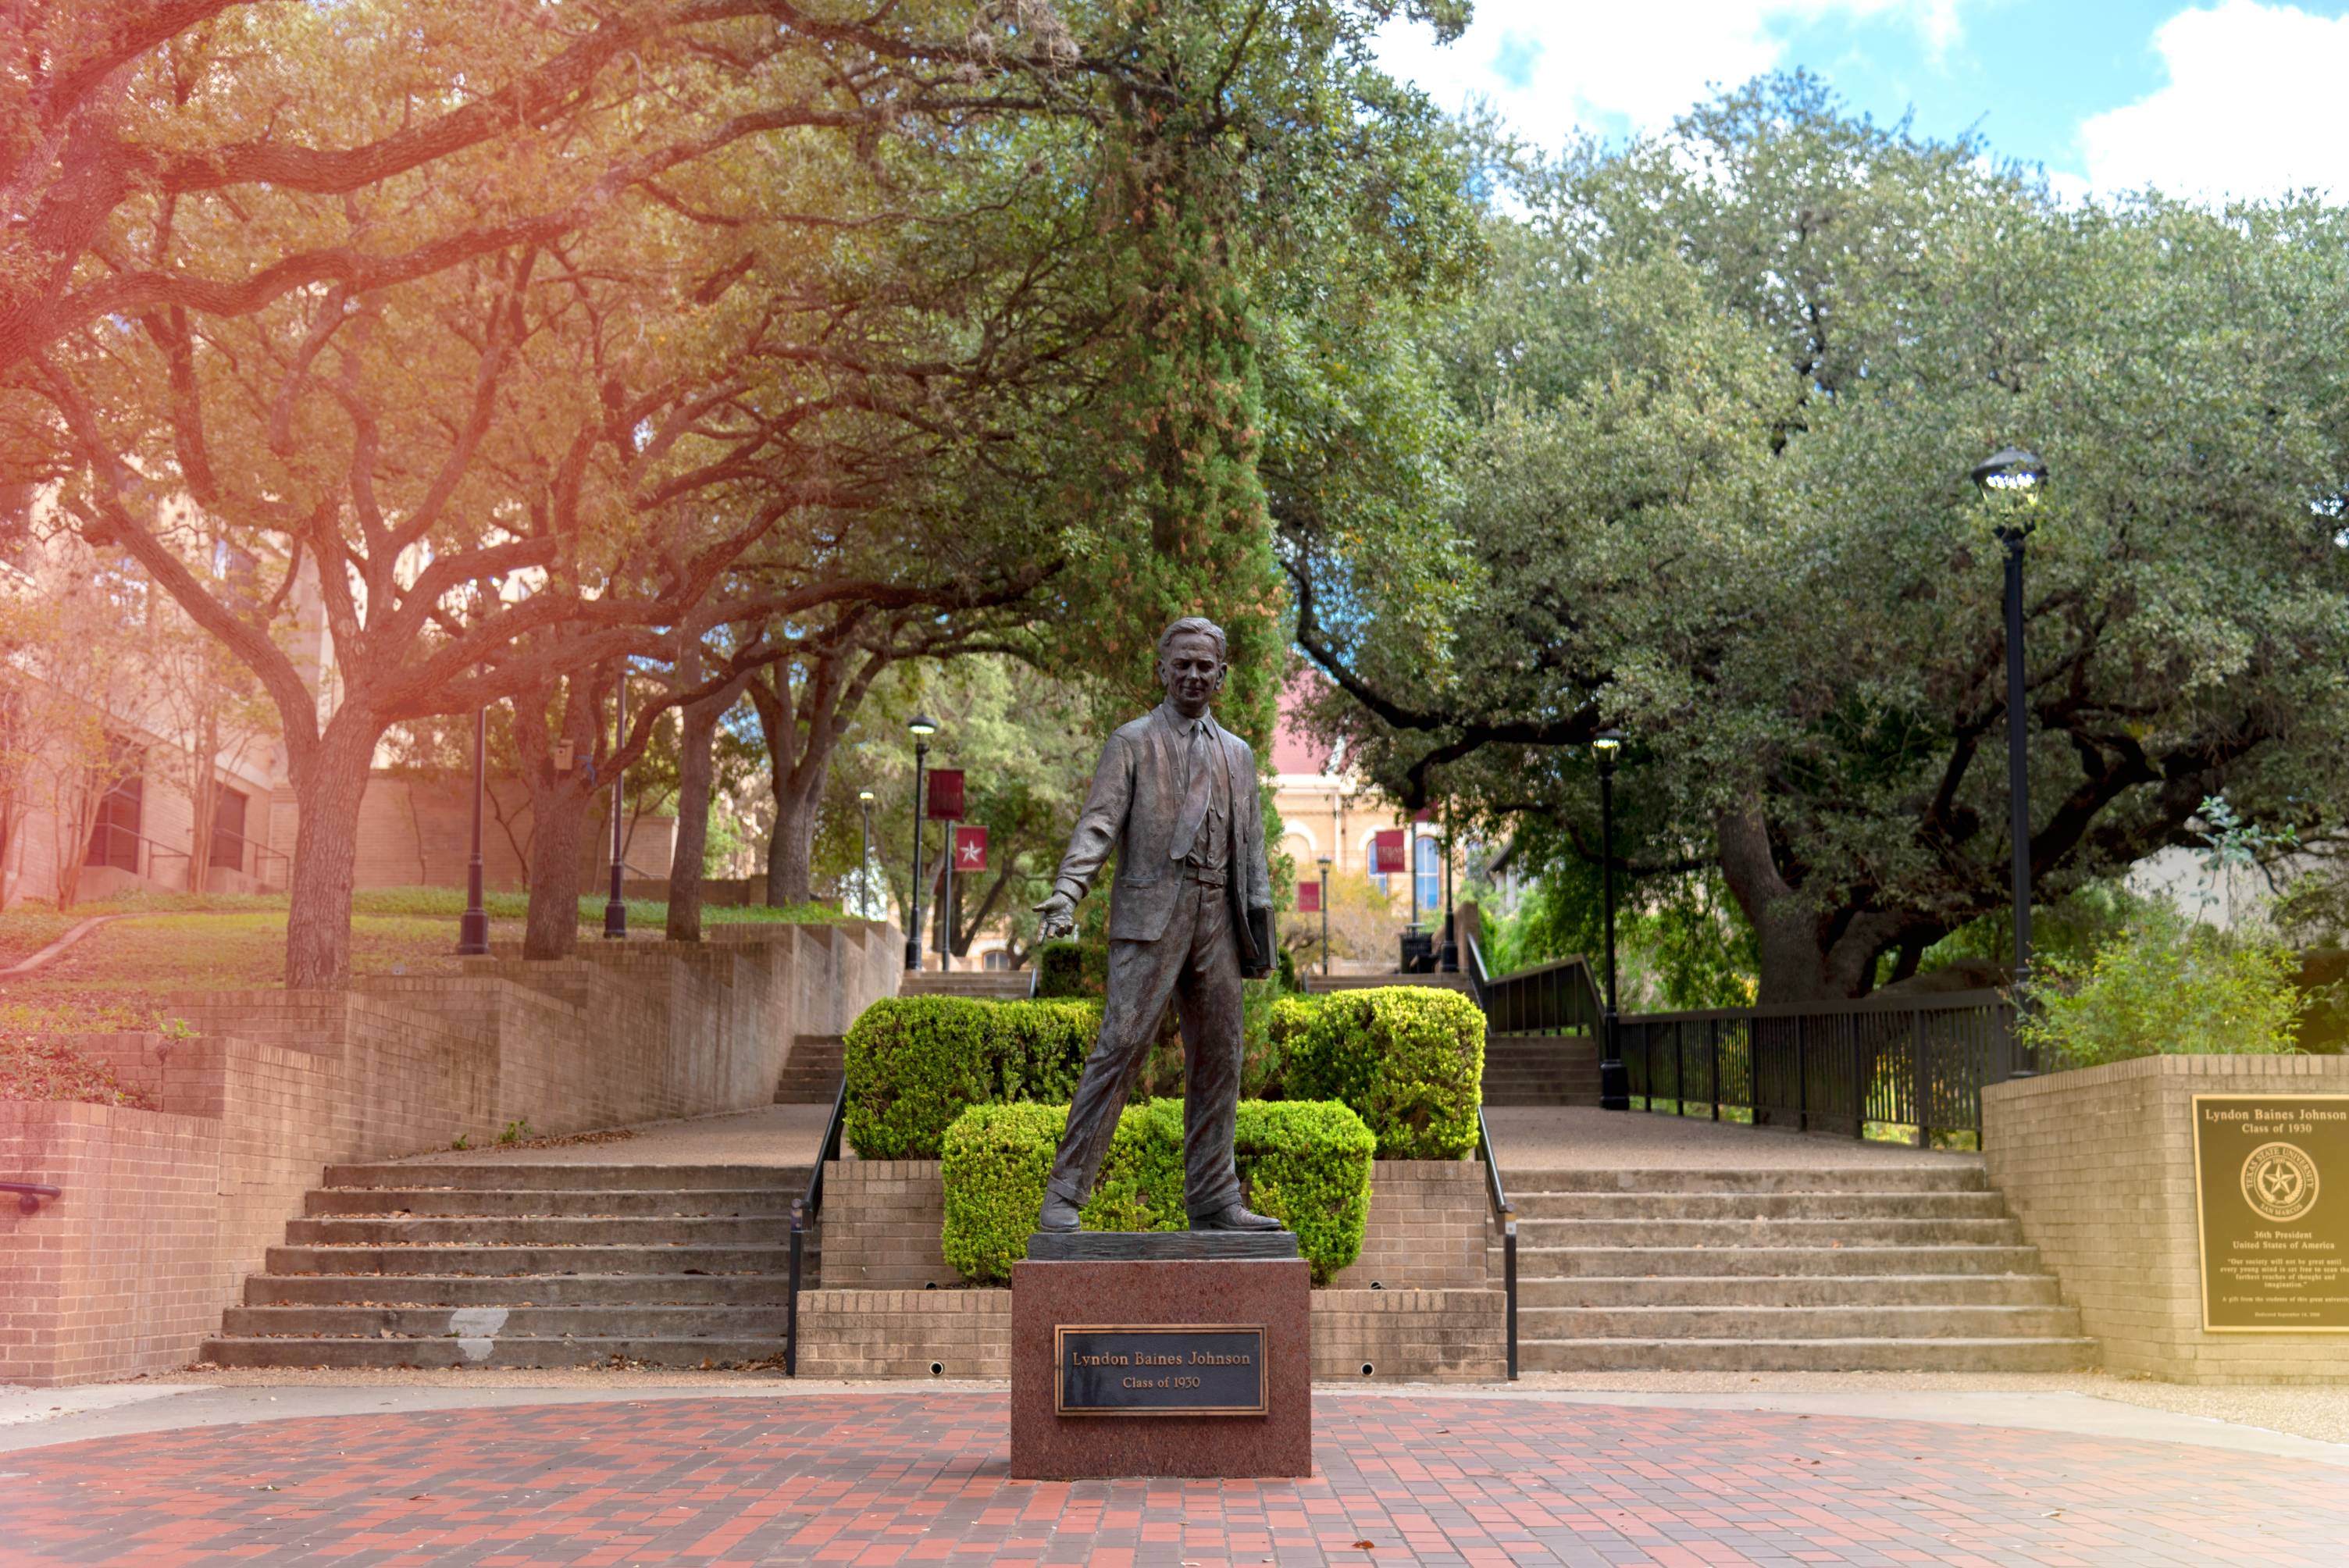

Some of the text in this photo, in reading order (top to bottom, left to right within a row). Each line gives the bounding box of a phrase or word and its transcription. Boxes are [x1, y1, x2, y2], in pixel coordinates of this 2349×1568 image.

[2205, 1108, 2347, 1123] Lyndon Baines Johnson
[2241, 1123, 2312, 1133] Class of 1930
[2246, 1147, 2315, 1189] TEXAS STATE UNIVERSITY
[2260, 1203, 2303, 1217] SAN MARCOS
[2275, 1230, 2312, 1238] President
[2233, 1241, 2335, 1249] United States of America
[1072, 1351, 1250, 1367] Lyndon Baines Johnson
[1122, 1377, 1201, 1388] Class of 1930
